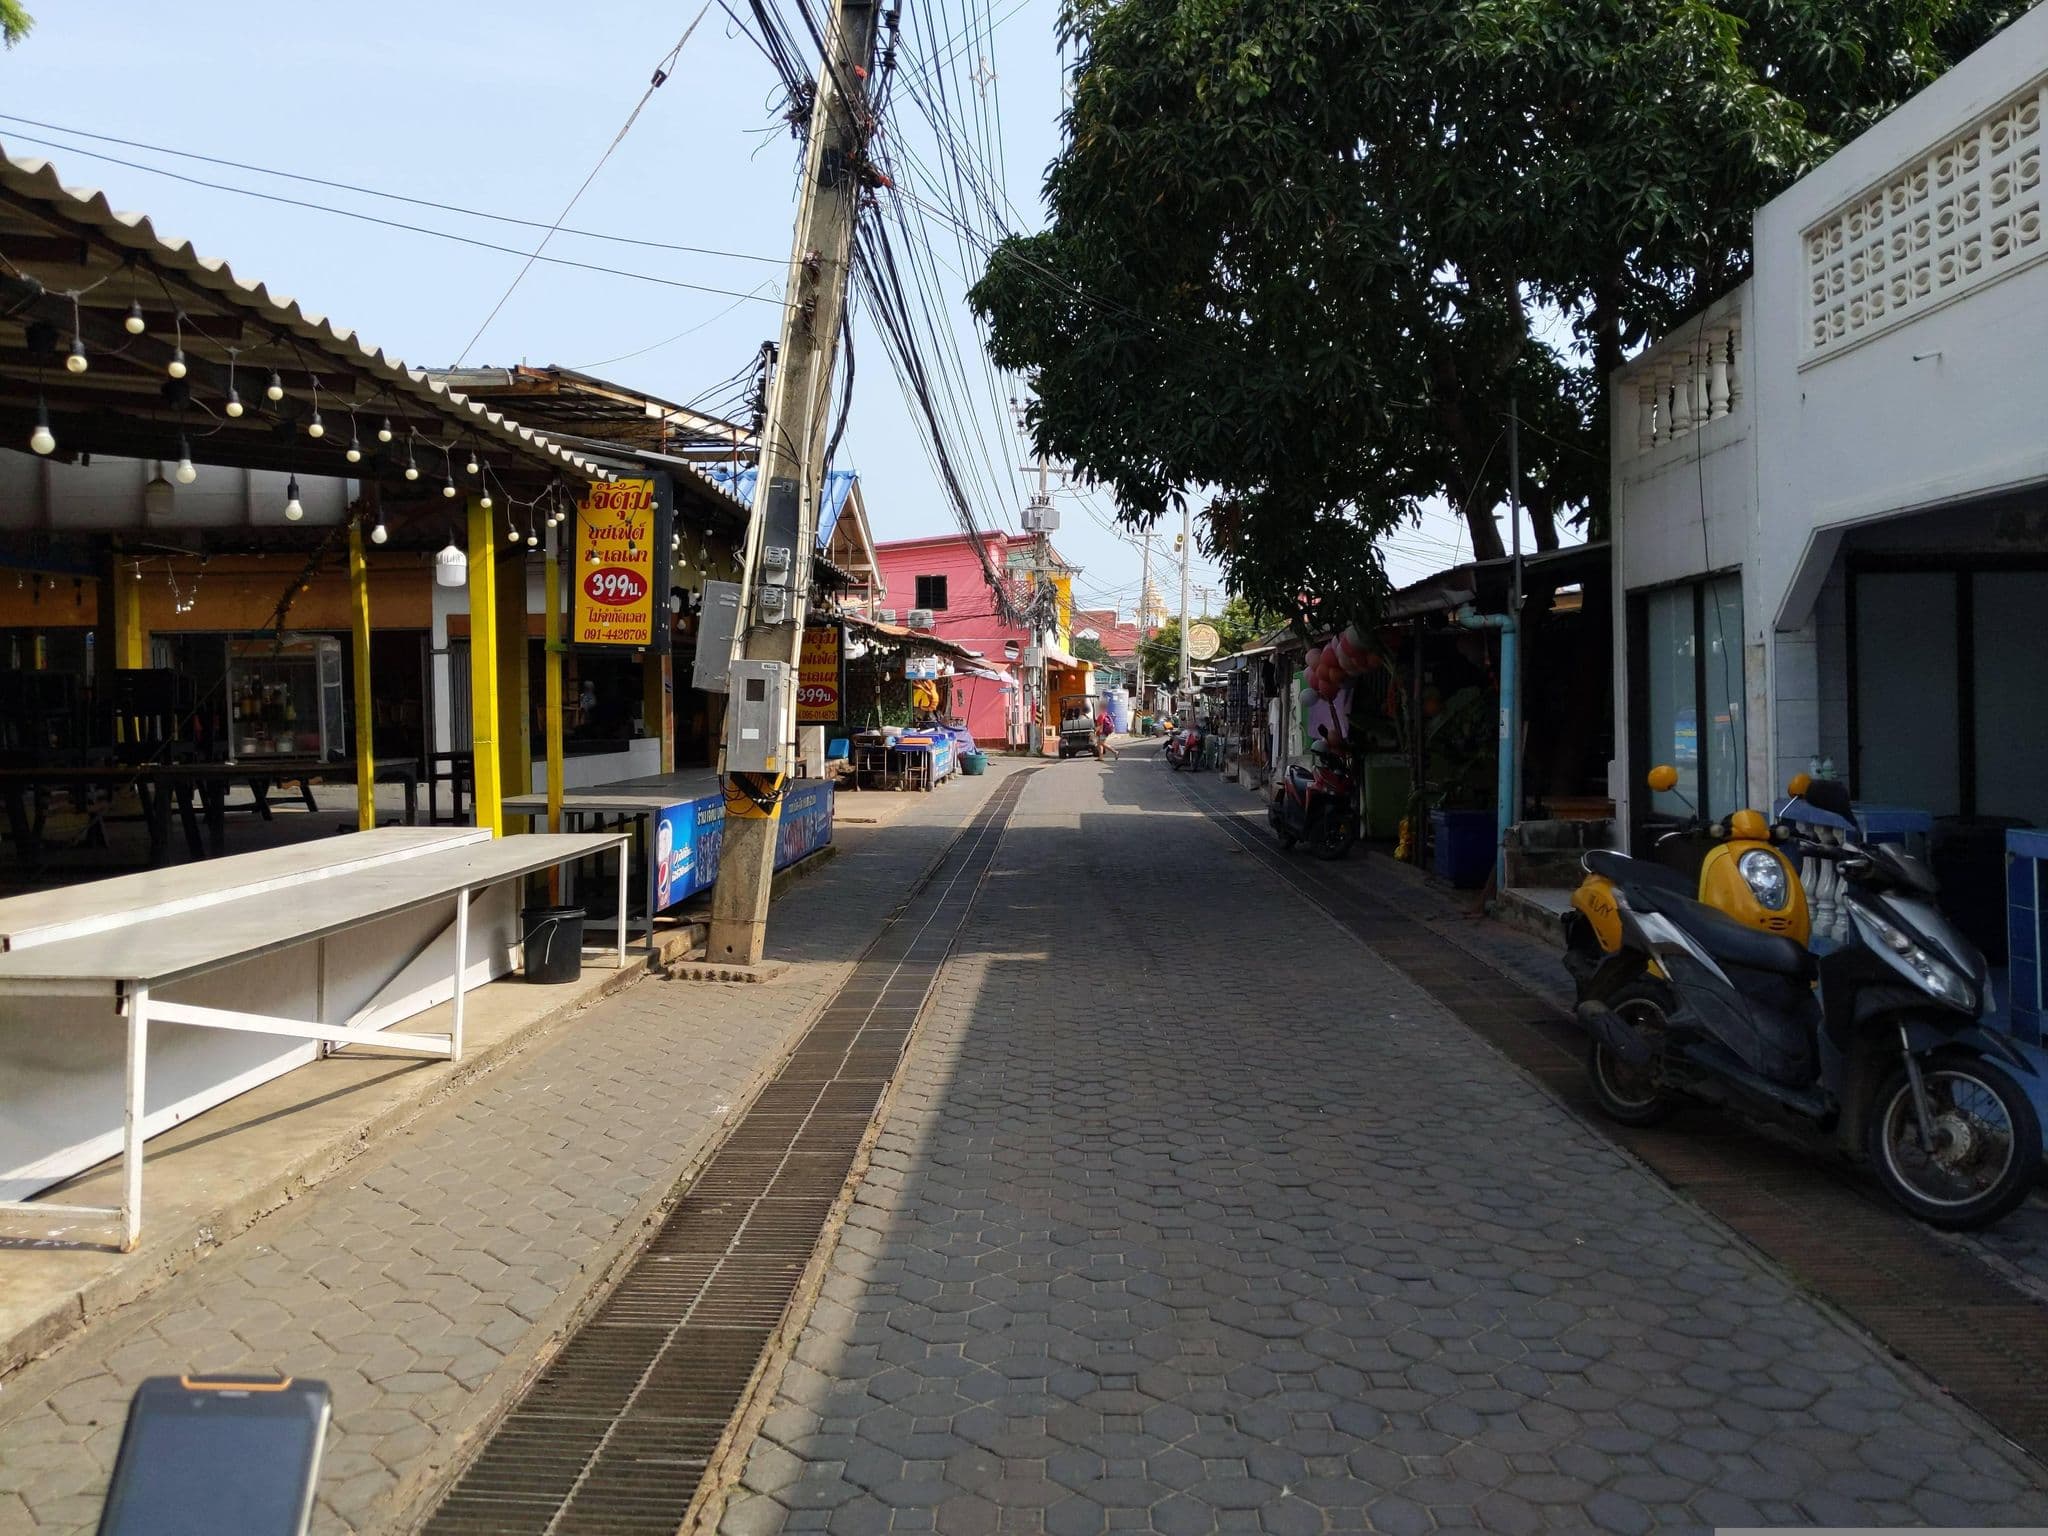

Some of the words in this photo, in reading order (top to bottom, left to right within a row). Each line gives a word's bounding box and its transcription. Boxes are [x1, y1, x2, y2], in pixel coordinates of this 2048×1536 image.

[592, 573, 642, 597] 399บ.
[586, 607, 647, 623] ไม่จำกัดเวลา
[584, 628, 648, 640] 091-4426708
